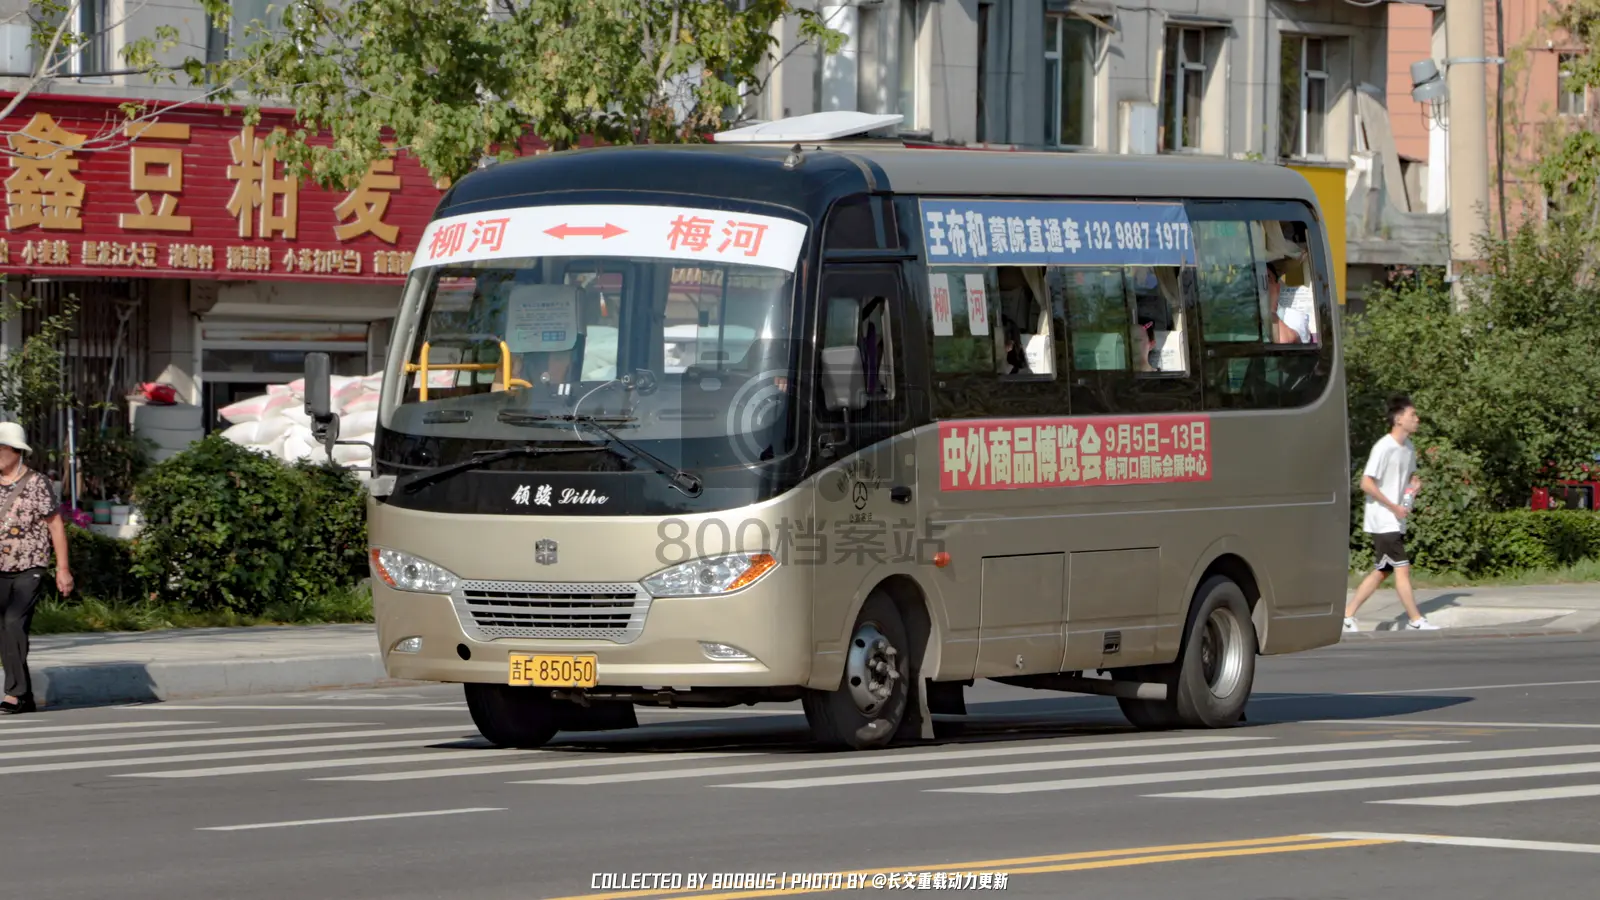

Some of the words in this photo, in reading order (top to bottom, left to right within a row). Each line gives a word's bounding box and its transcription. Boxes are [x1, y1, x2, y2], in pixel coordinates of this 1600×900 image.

[428, 217, 511, 260] 柳河
[666, 214, 769, 257] 梅河
[1085, 220, 1112, 249] 132
[1115, 221, 1150, 250] 9887
[1156, 221, 1189, 250] 1977
[81, 240, 157, 267] 黑龙江大豆
[1105, 421, 1206, 453] 9月5日-13日
[943, 423, 1102, 486] 中外商品博览会
[1105, 453, 1208, 481] 梅河口国际会展中心
[511, 484, 553, 507] 领骏
[557, 487, 610, 505] Lithe
